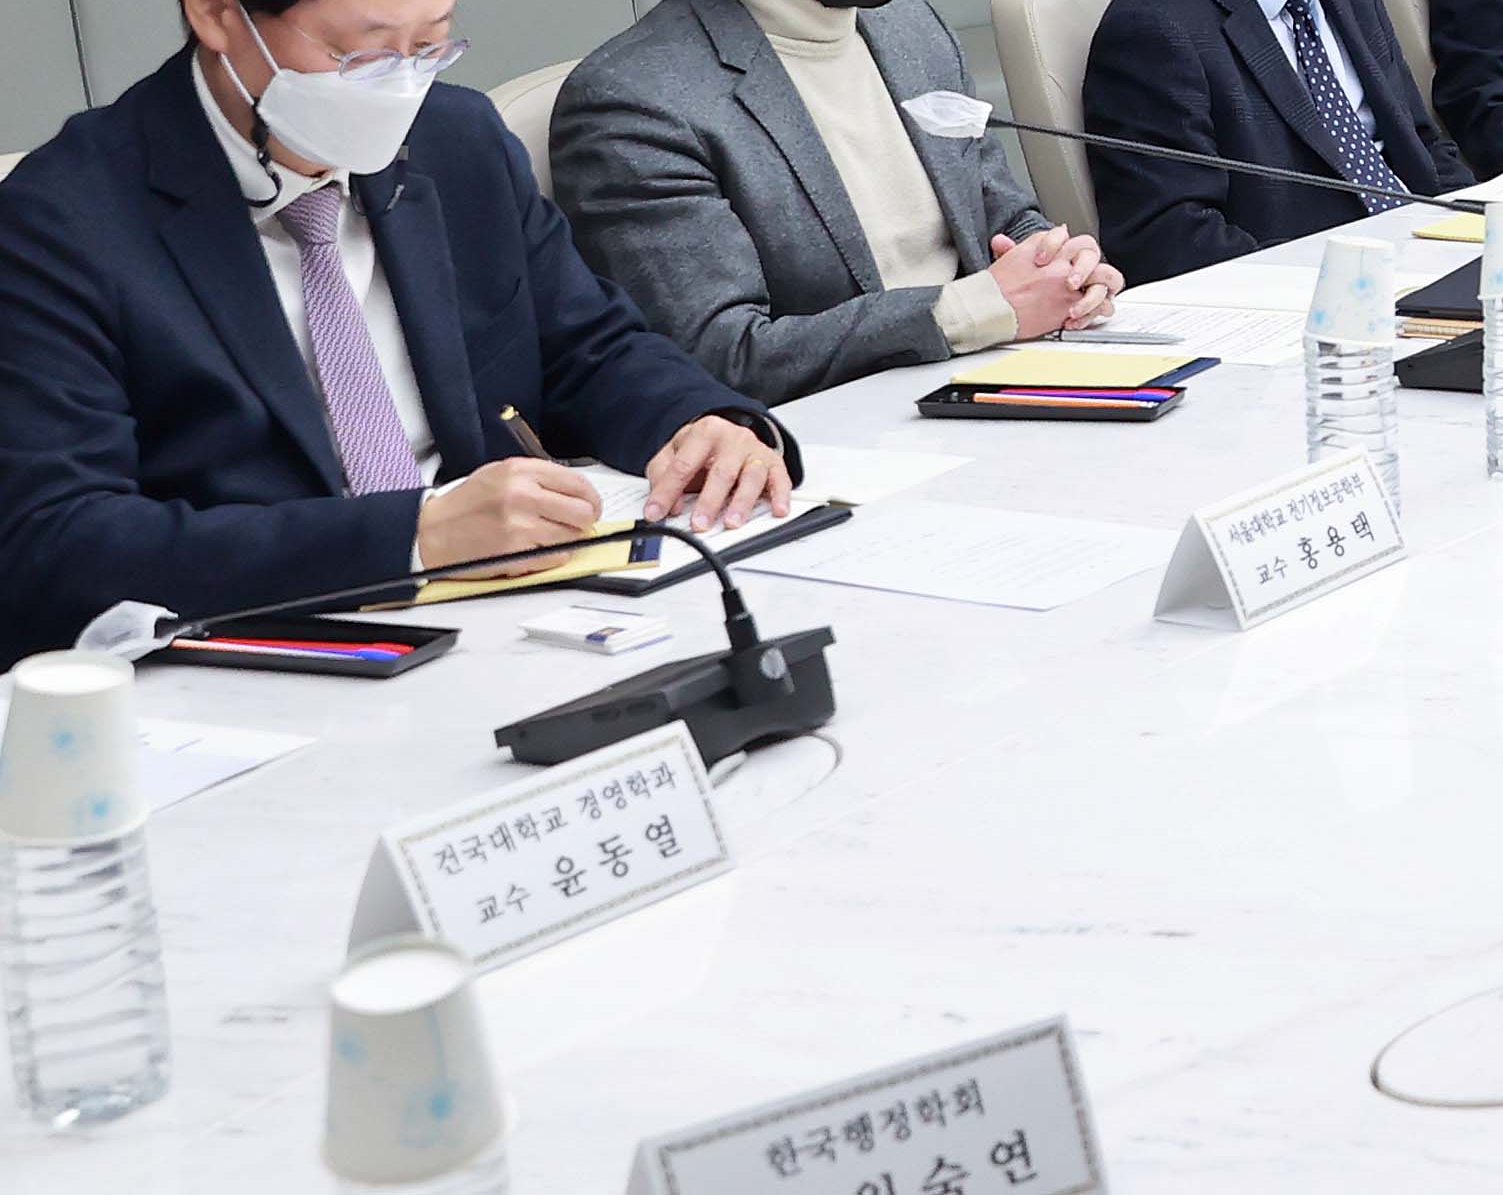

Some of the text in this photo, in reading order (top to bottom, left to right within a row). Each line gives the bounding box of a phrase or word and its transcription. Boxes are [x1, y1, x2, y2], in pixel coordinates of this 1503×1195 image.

[1228, 473, 1365, 545] 서울대학교 전기정보공학부
[1257, 556, 1288, 585] 교수
[434, 762, 678, 877] 건국대학교 경영학과
[477, 886, 532, 924] 교수
[767, 1079, 985, 1177] 한국행정학회
